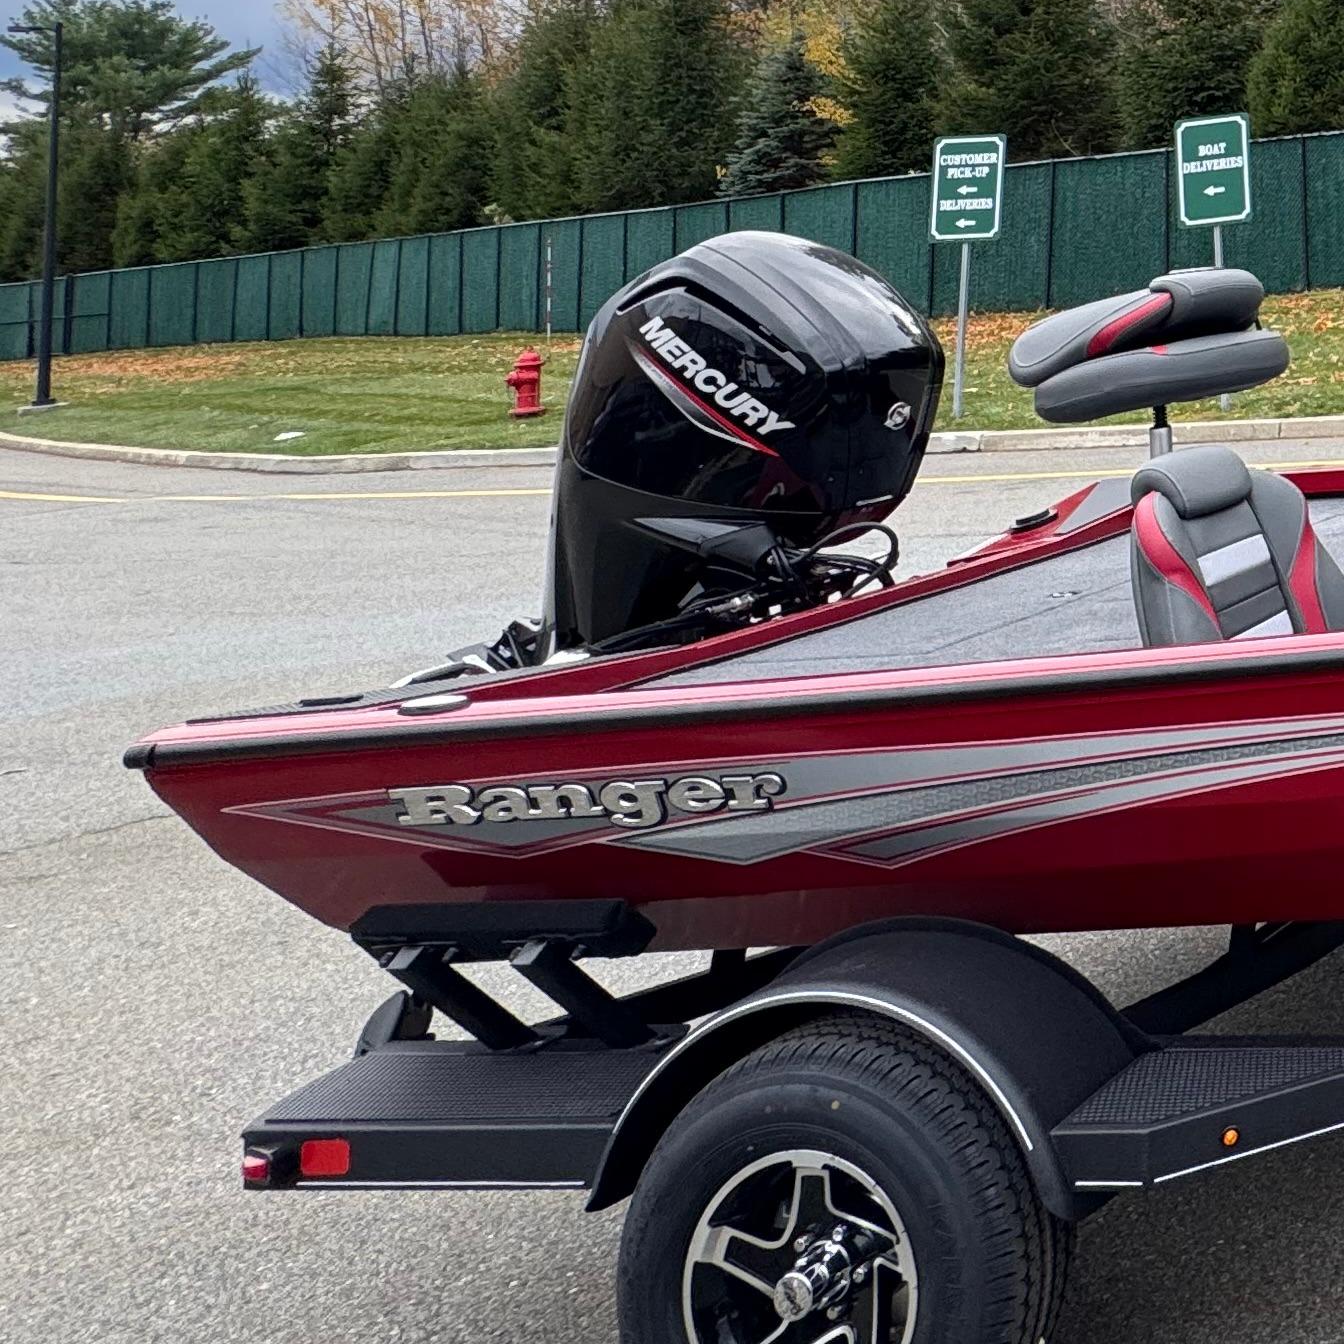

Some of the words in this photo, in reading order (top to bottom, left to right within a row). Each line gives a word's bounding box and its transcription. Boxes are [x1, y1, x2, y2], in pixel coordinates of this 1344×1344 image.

[1198, 142, 1227, 157] BOAT
[940, 153, 998, 166] CUSTOMER
[1183, 156, 1243, 174] DELIVERIES
[946, 166, 990, 179] PICK-UP
[939, 198, 993, 211] DELIVERIES
[639, 316, 796, 435] MERCURY
[387, 771, 787, 828] Ranger
